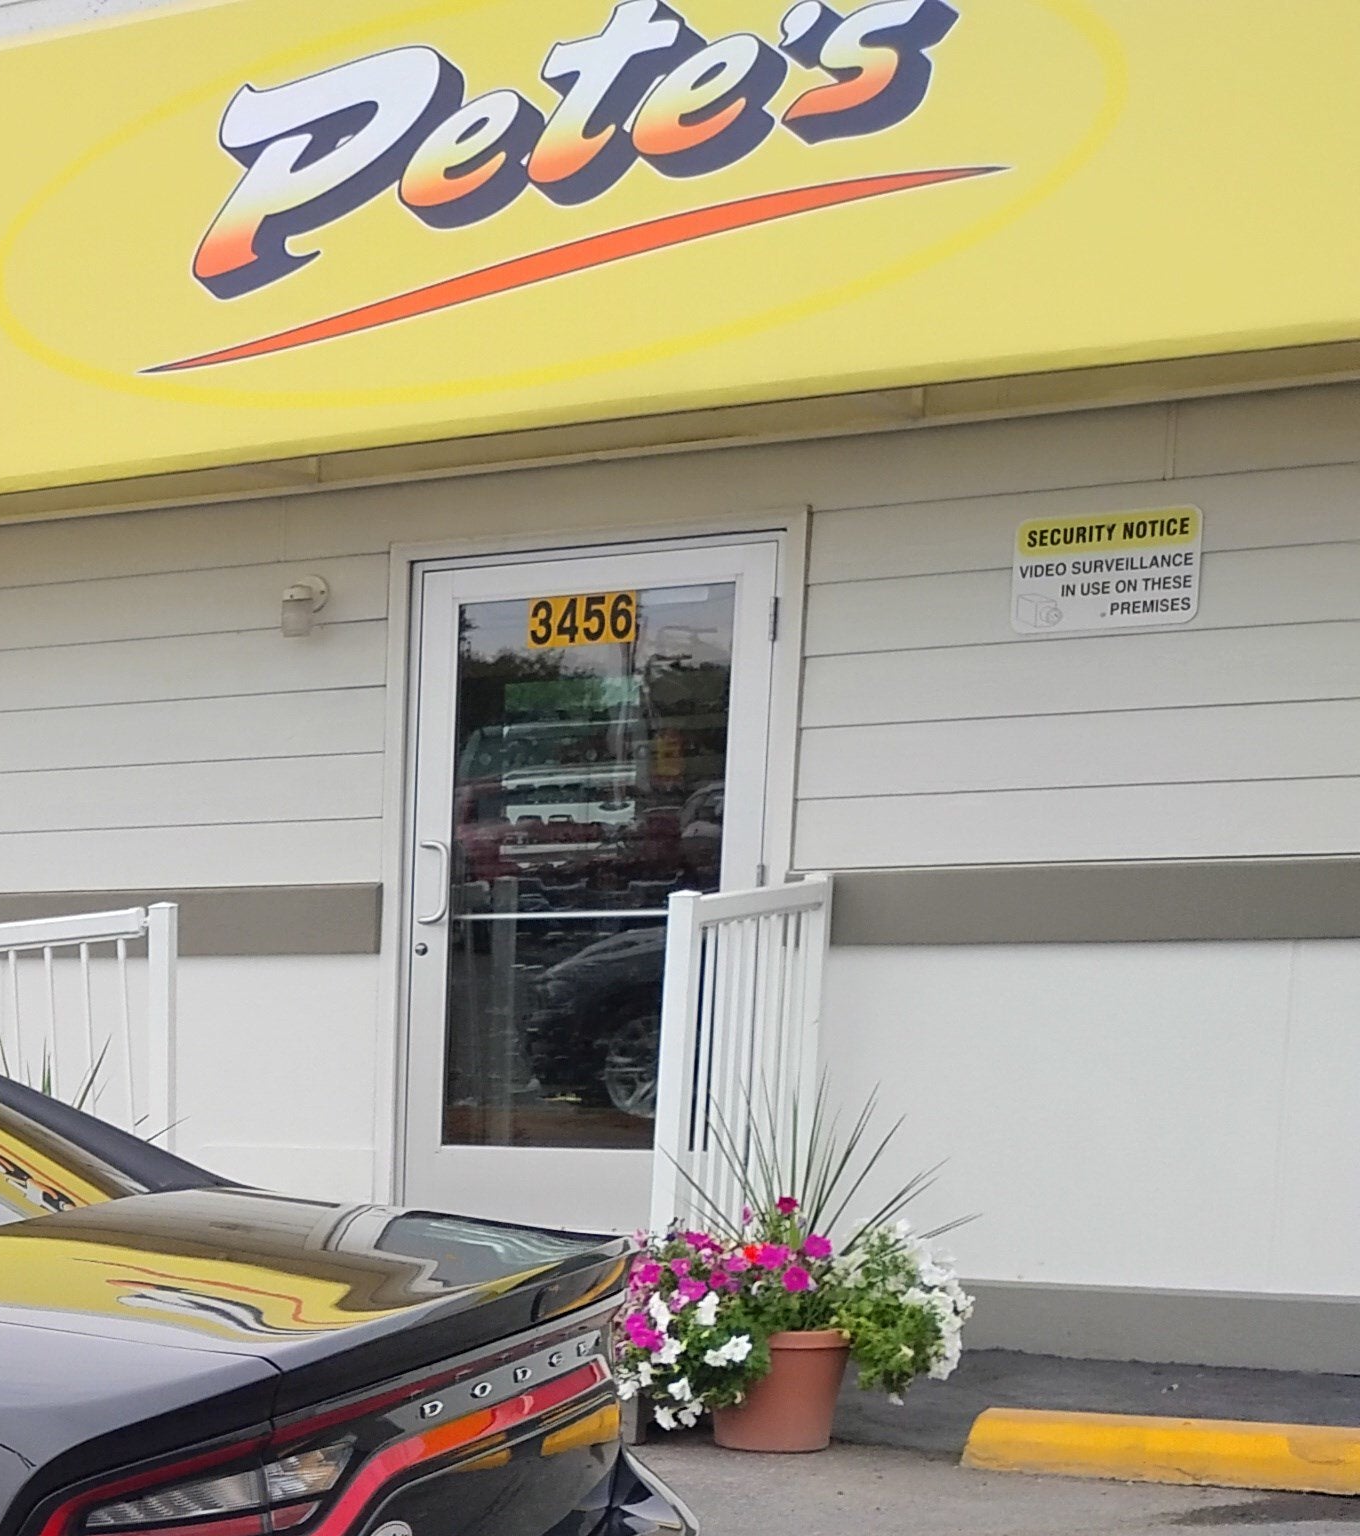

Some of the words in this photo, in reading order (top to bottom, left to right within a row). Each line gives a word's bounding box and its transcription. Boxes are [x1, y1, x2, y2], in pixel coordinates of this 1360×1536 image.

[191, 0, 959, 300] Pete's
[1026, 523, 1116, 548] SECURITY
[1122, 517, 1190, 540] NOTICE
[1019, 562, 1067, 579] VIDEO
[1071, 552, 1194, 575] SURVEILLANCE
[1061, 584, 1076, 597] IN
[1080, 580, 1111, 597] USE
[1115, 579, 1138, 594] ON
[1142, 575, 1192, 592] THESE
[529, 592, 634, 646] 3456
[1109, 596, 1191, 616] PREMISES
